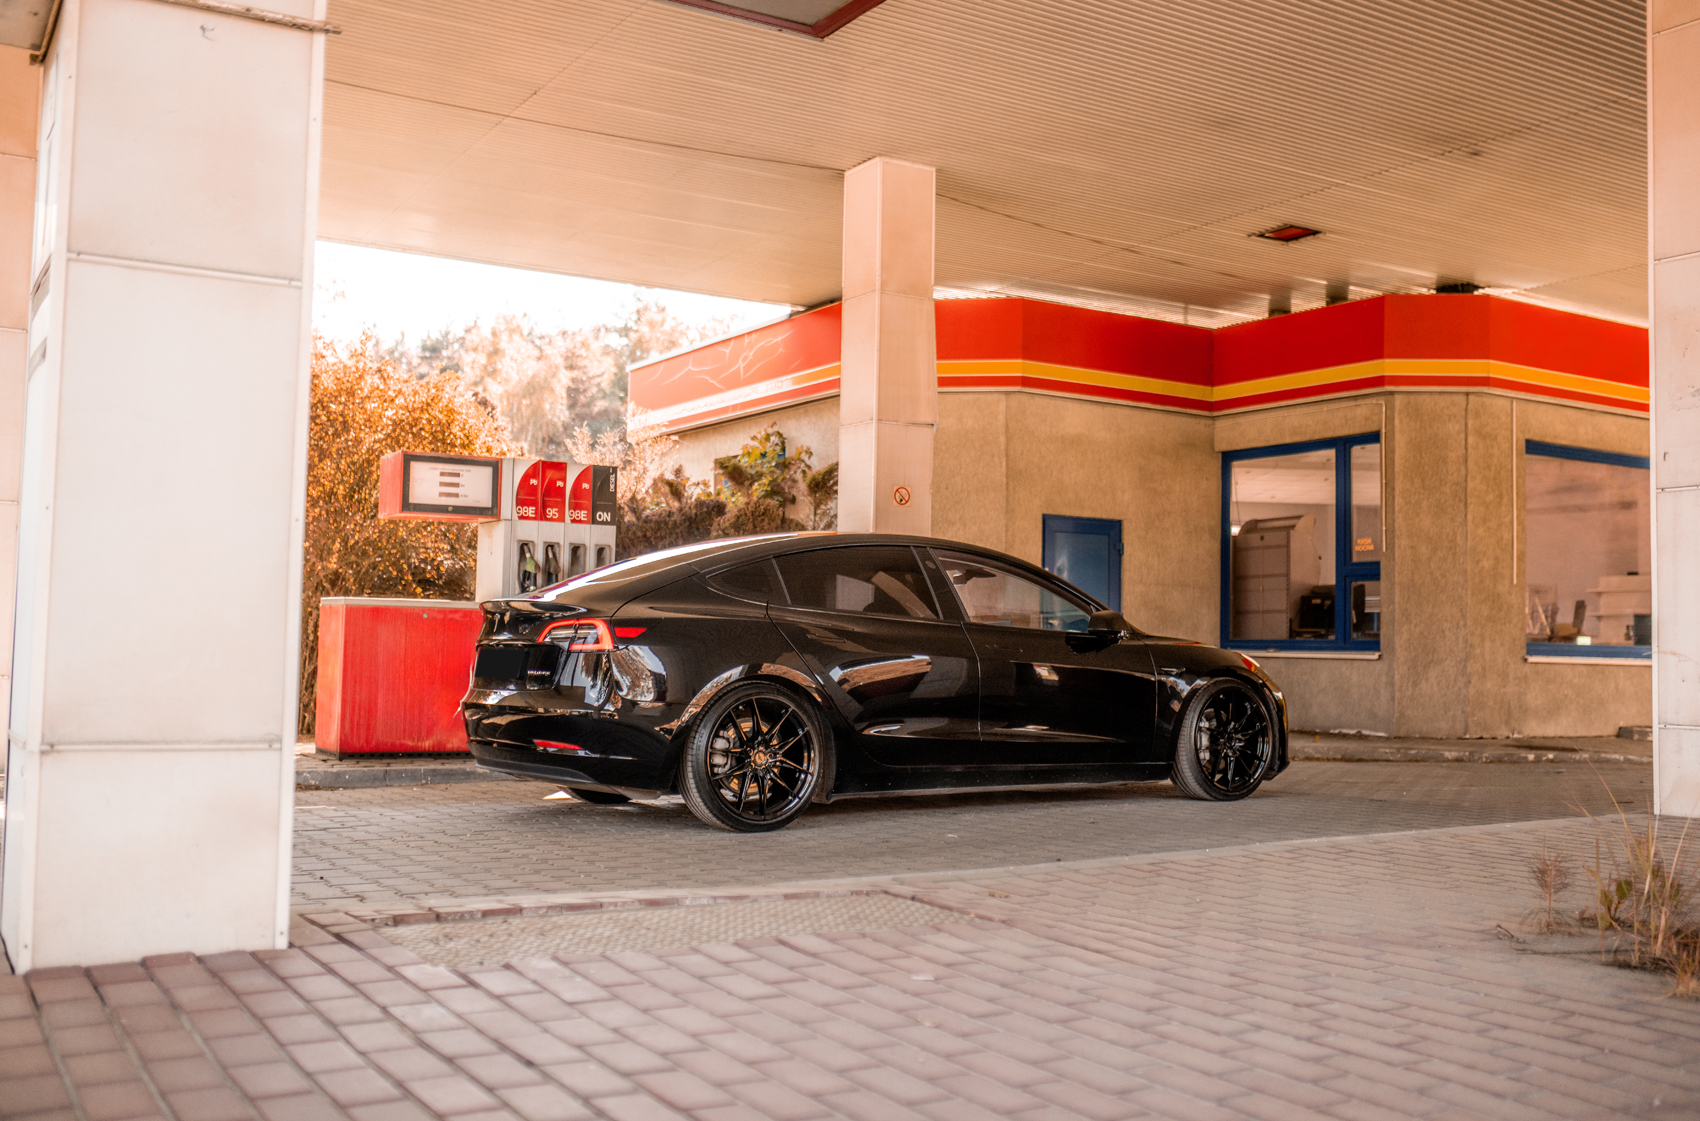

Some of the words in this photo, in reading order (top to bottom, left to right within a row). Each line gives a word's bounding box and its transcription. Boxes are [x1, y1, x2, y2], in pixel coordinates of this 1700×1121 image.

[516, 506, 536, 517] 98E
[546, 508, 558, 518] 95
[569, 510, 587, 520] 98E
[596, 512, 611, 522] ON
